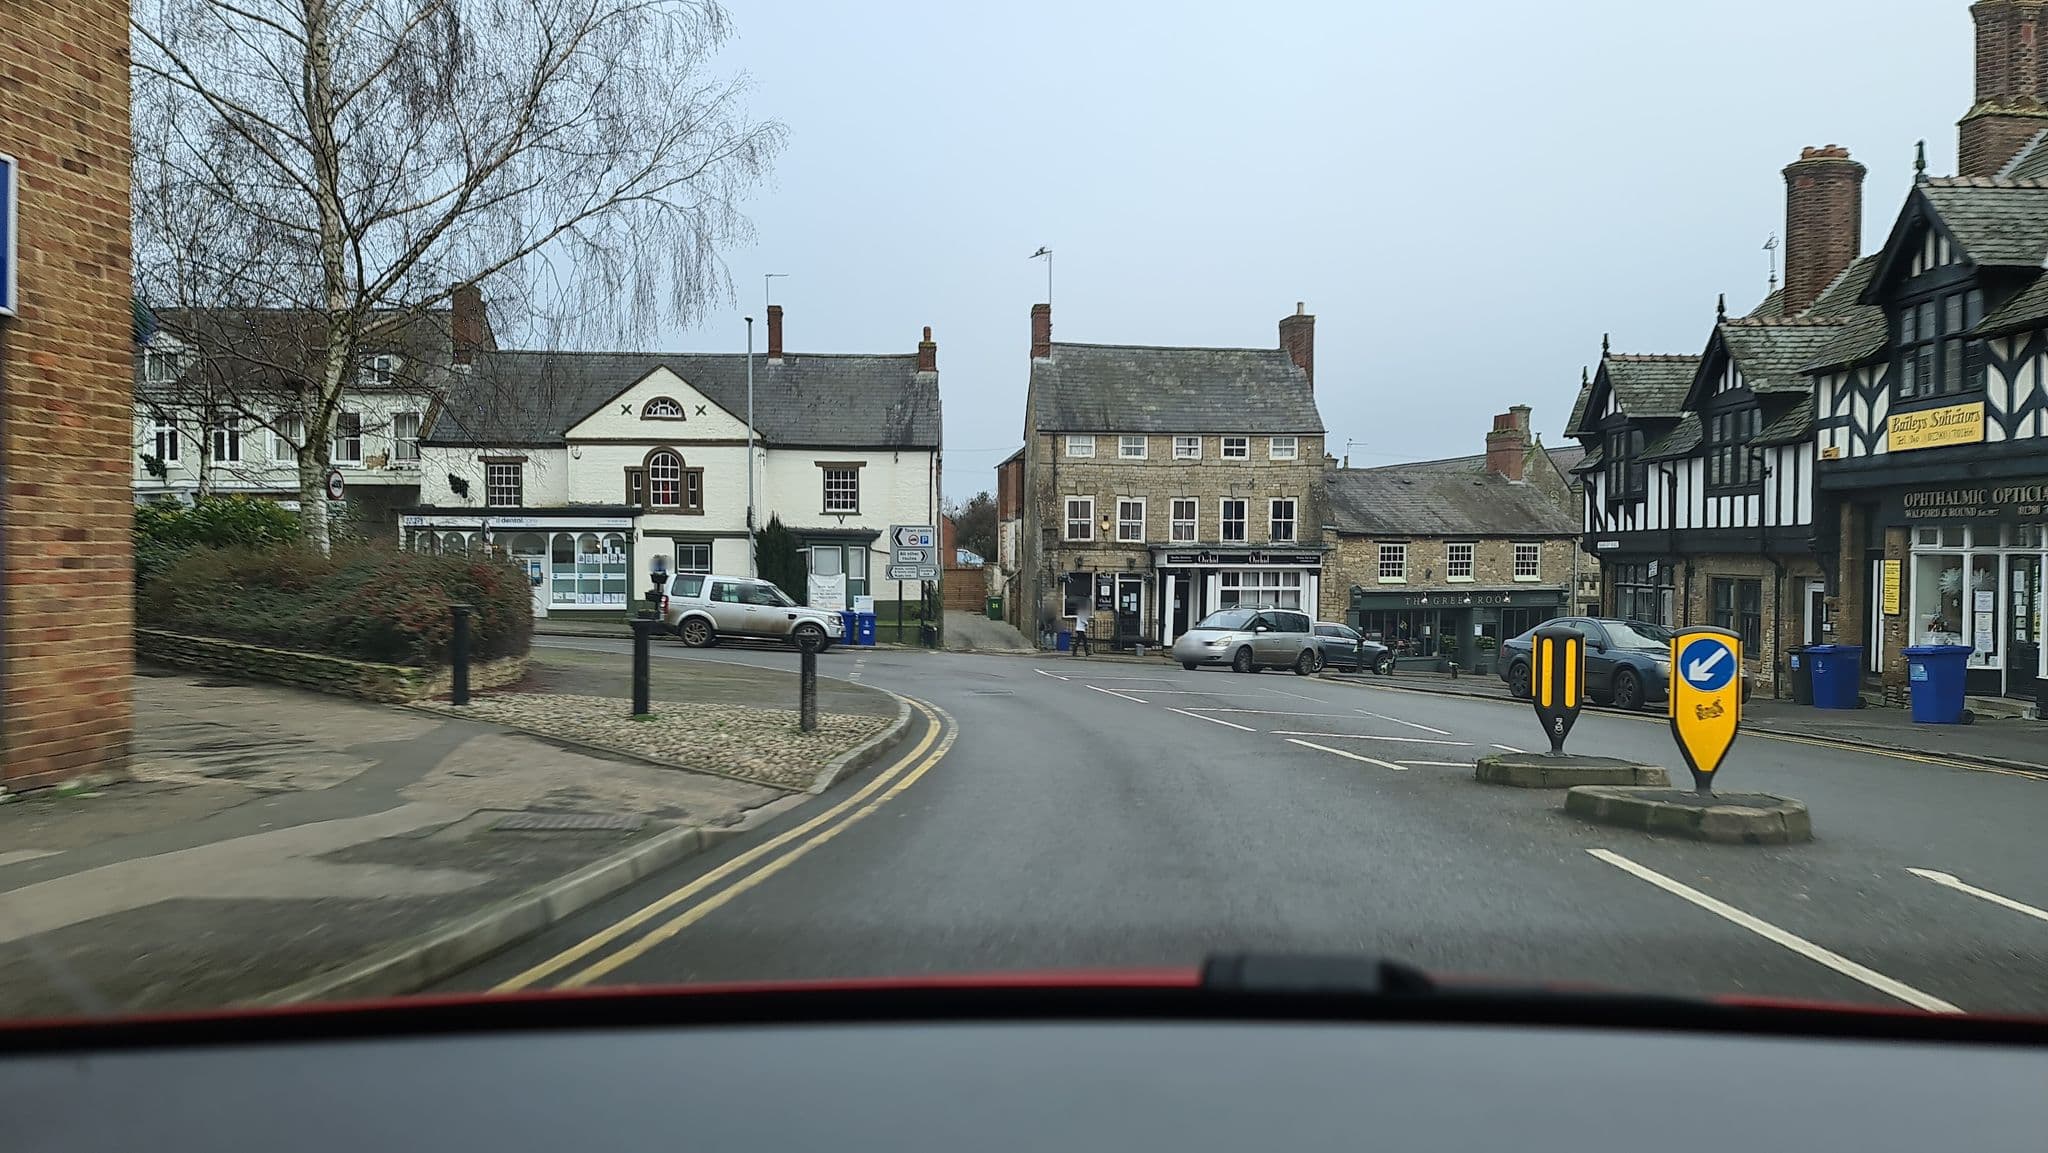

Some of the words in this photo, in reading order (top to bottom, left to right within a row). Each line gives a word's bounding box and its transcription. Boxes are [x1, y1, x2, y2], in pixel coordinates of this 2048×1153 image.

[1891, 415, 1928, 434] Baileys
[1930, 408, 1981, 427] Solicitors
[1904, 489, 1988, 507] OPHTHALMIC
[1905, 508, 1940, 518] WALFORD
